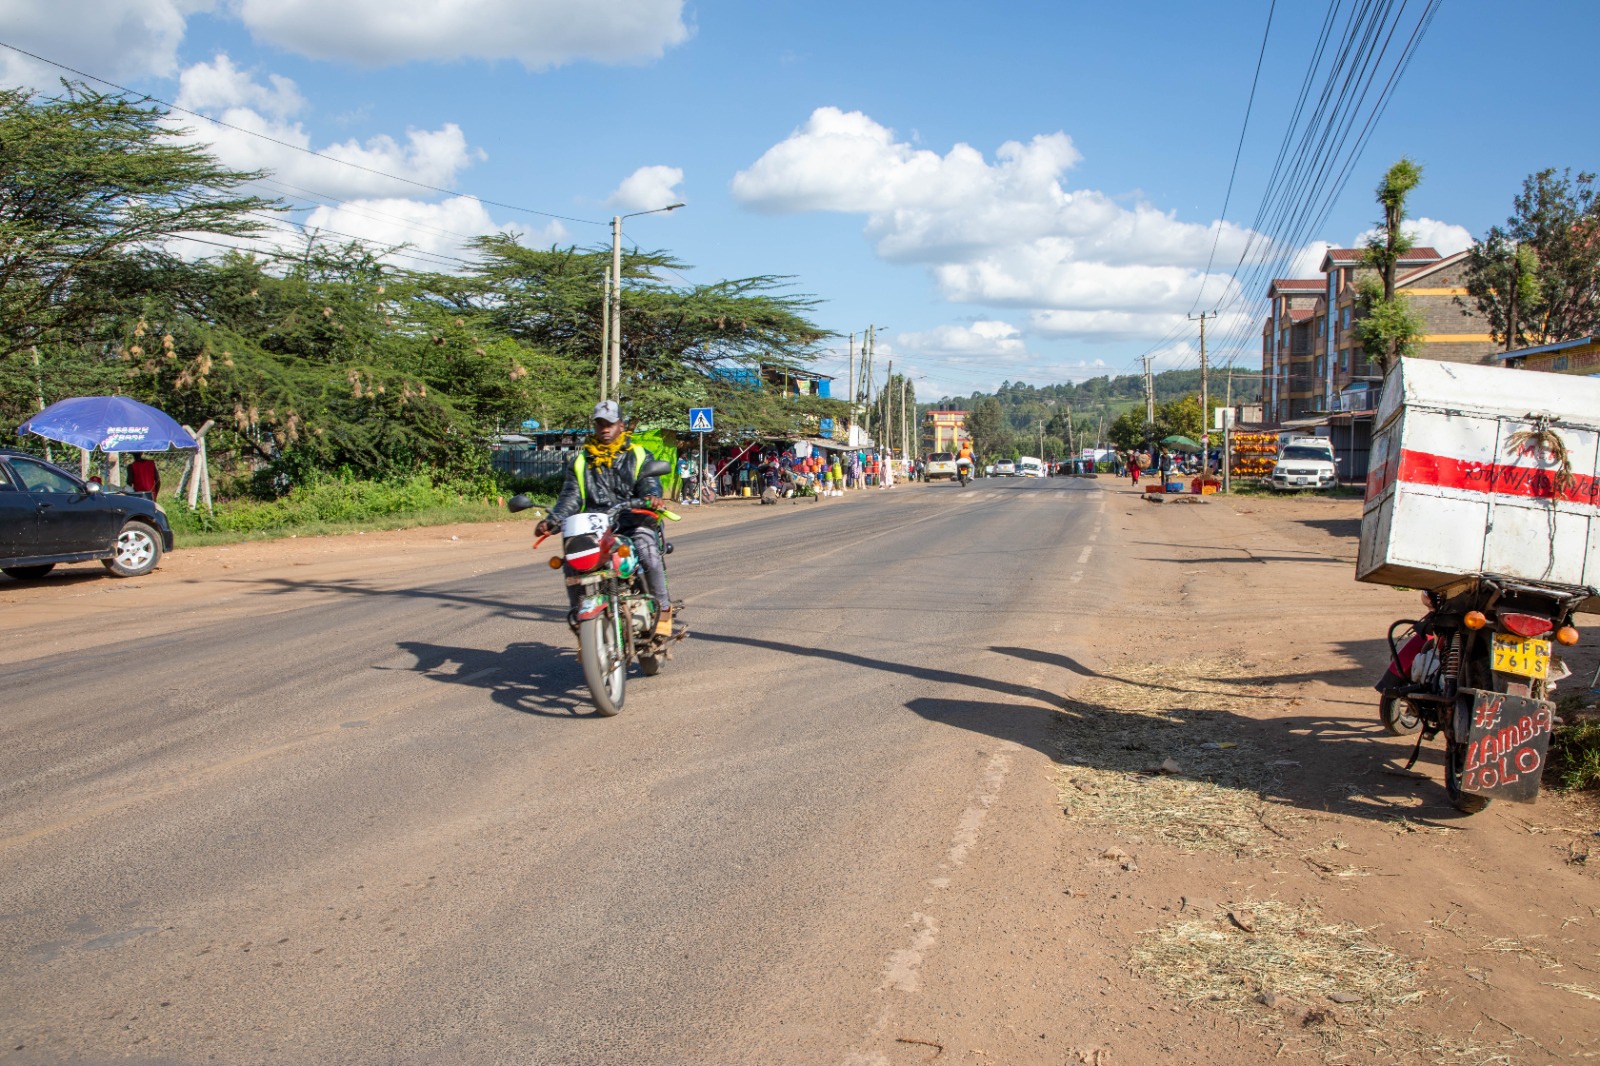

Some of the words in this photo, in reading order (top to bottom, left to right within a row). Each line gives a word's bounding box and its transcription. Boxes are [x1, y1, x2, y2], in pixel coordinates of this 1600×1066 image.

[1473, 700, 1502, 730] #
[1466, 708, 1552, 771] LAMBA
[1464, 747, 1541, 791] LOLO
